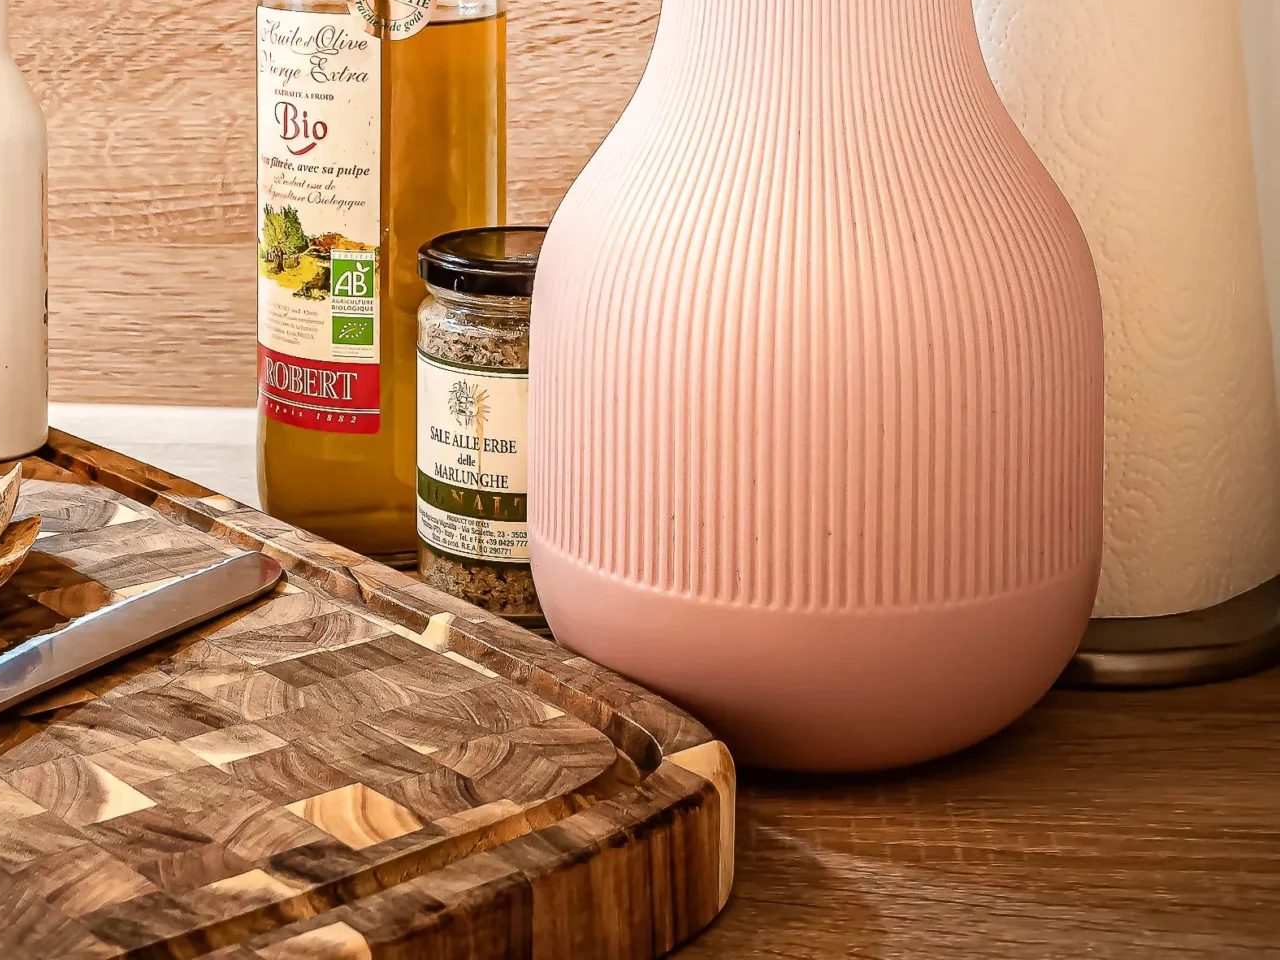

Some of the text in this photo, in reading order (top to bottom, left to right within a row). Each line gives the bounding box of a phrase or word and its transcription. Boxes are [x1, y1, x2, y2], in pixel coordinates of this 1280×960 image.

[403, 11, 425, 32] goût
[261, 19, 303, 48] Huile
[307, 55, 370, 84] Extra
[310, 93, 335, 102] FROID
[274, 101, 329, 141] Bio
[297, 162, 320, 174] avec
[321, 166, 335, 175] sa
[335, 164, 371, 179] pulpe
[324, 179, 336, 191] de
[307, 191, 367, 211] Biologique
[333, 270, 368, 297] AB
[331, 304, 374, 312] BIOLOGIQUE
[264, 355, 359, 401] ROBERT
[316, 412, 357, 424] 1882
[430, 425, 518, 455] SALE ALLE ERBE
[457, 454, 476, 468] delle
[434, 461, 509, 490] MARLUNGHE
[461, 524, 470, 534] Via
[496, 530, 506, 538] 23
[488, 548, 512, 556] 290771
[497, 540, 515, 548] 0429
